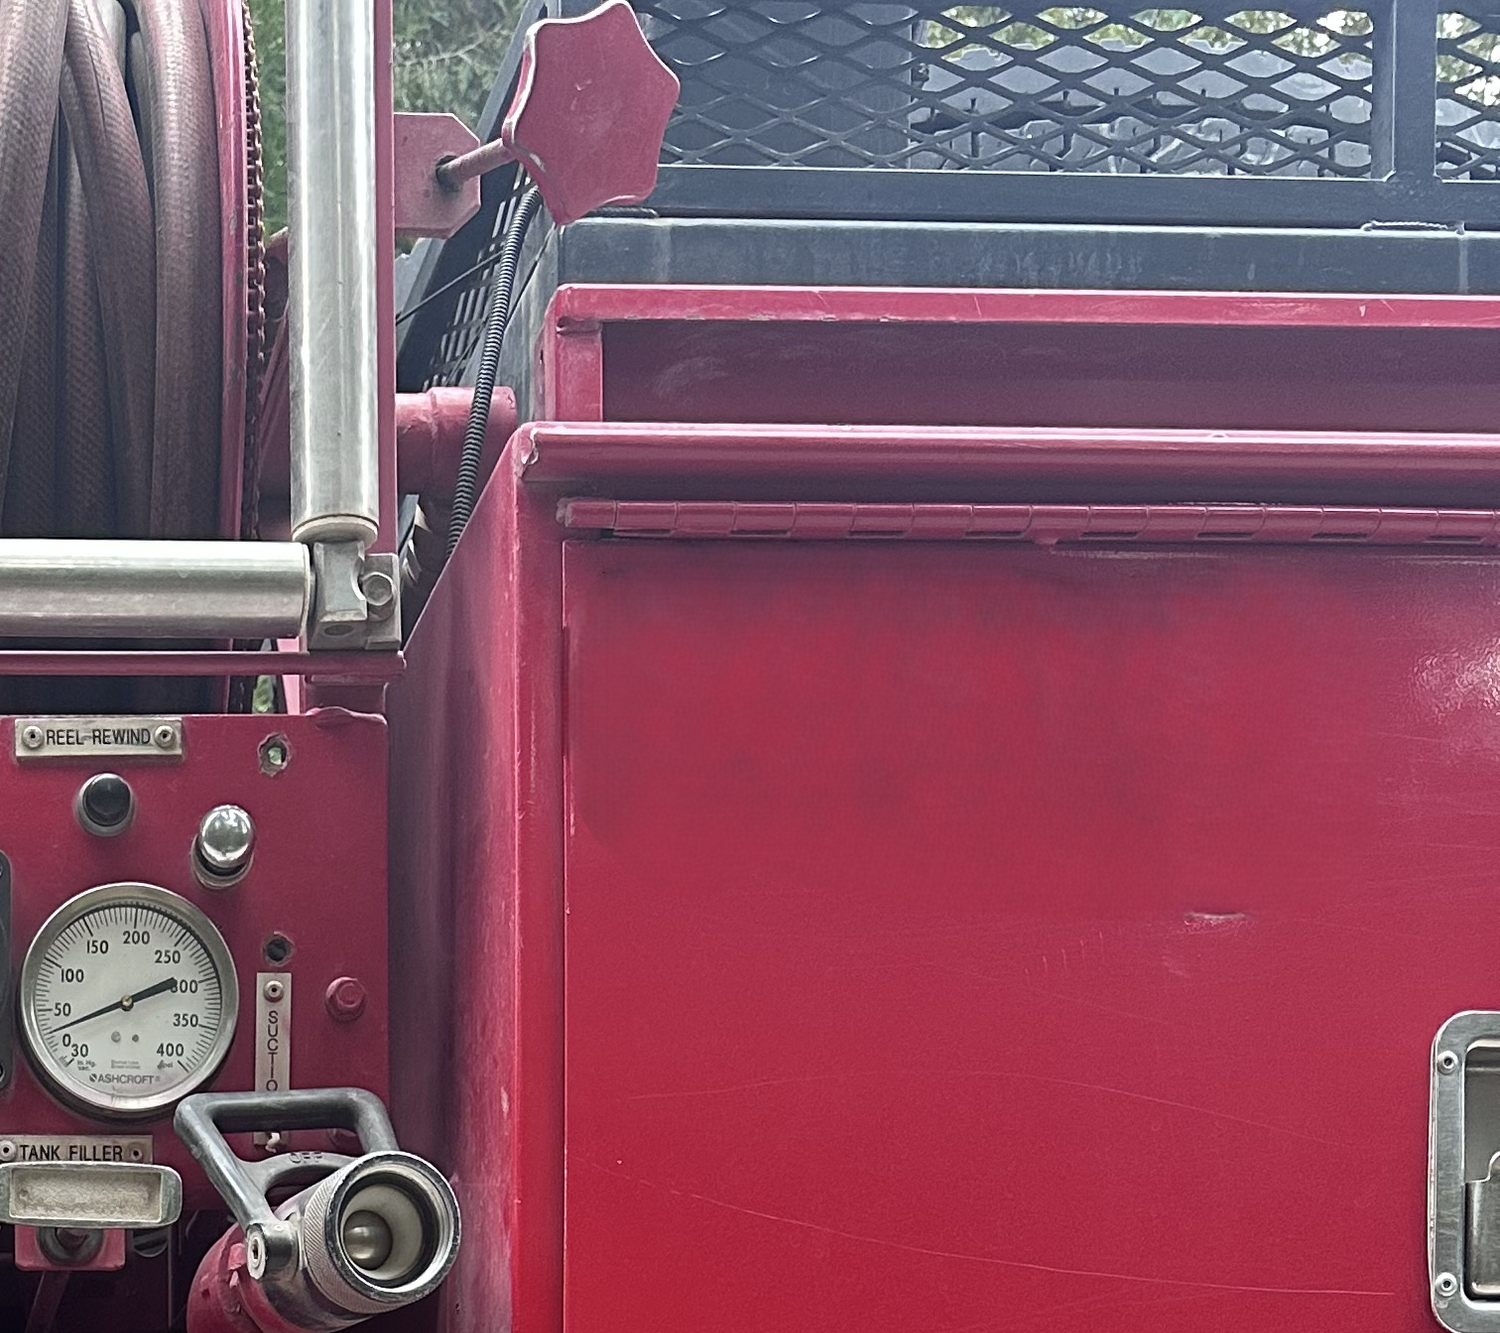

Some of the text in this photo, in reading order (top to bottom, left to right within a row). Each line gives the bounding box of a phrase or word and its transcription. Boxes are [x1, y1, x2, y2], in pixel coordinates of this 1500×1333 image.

[46, 728, 151, 745] REEL REWIND
[123, 931, 150, 945] 200
[87, 940, 109, 954] 150
[155, 950, 181, 964] 250
[61, 969, 84, 983] 100
[54, 1003, 72, 1017] 50
[173, 1014, 198, 1028] 350
[62, 1034, 72, 1048] 0
[71, 1044, 89, 1058] 30
[156, 1043, 184, 1057] 400
[266, 1010, 279, 1091] SUCTIO
[20, 1144, 123, 1160] TANK FILLER
[289, 1151, 324, 1164] OFF
